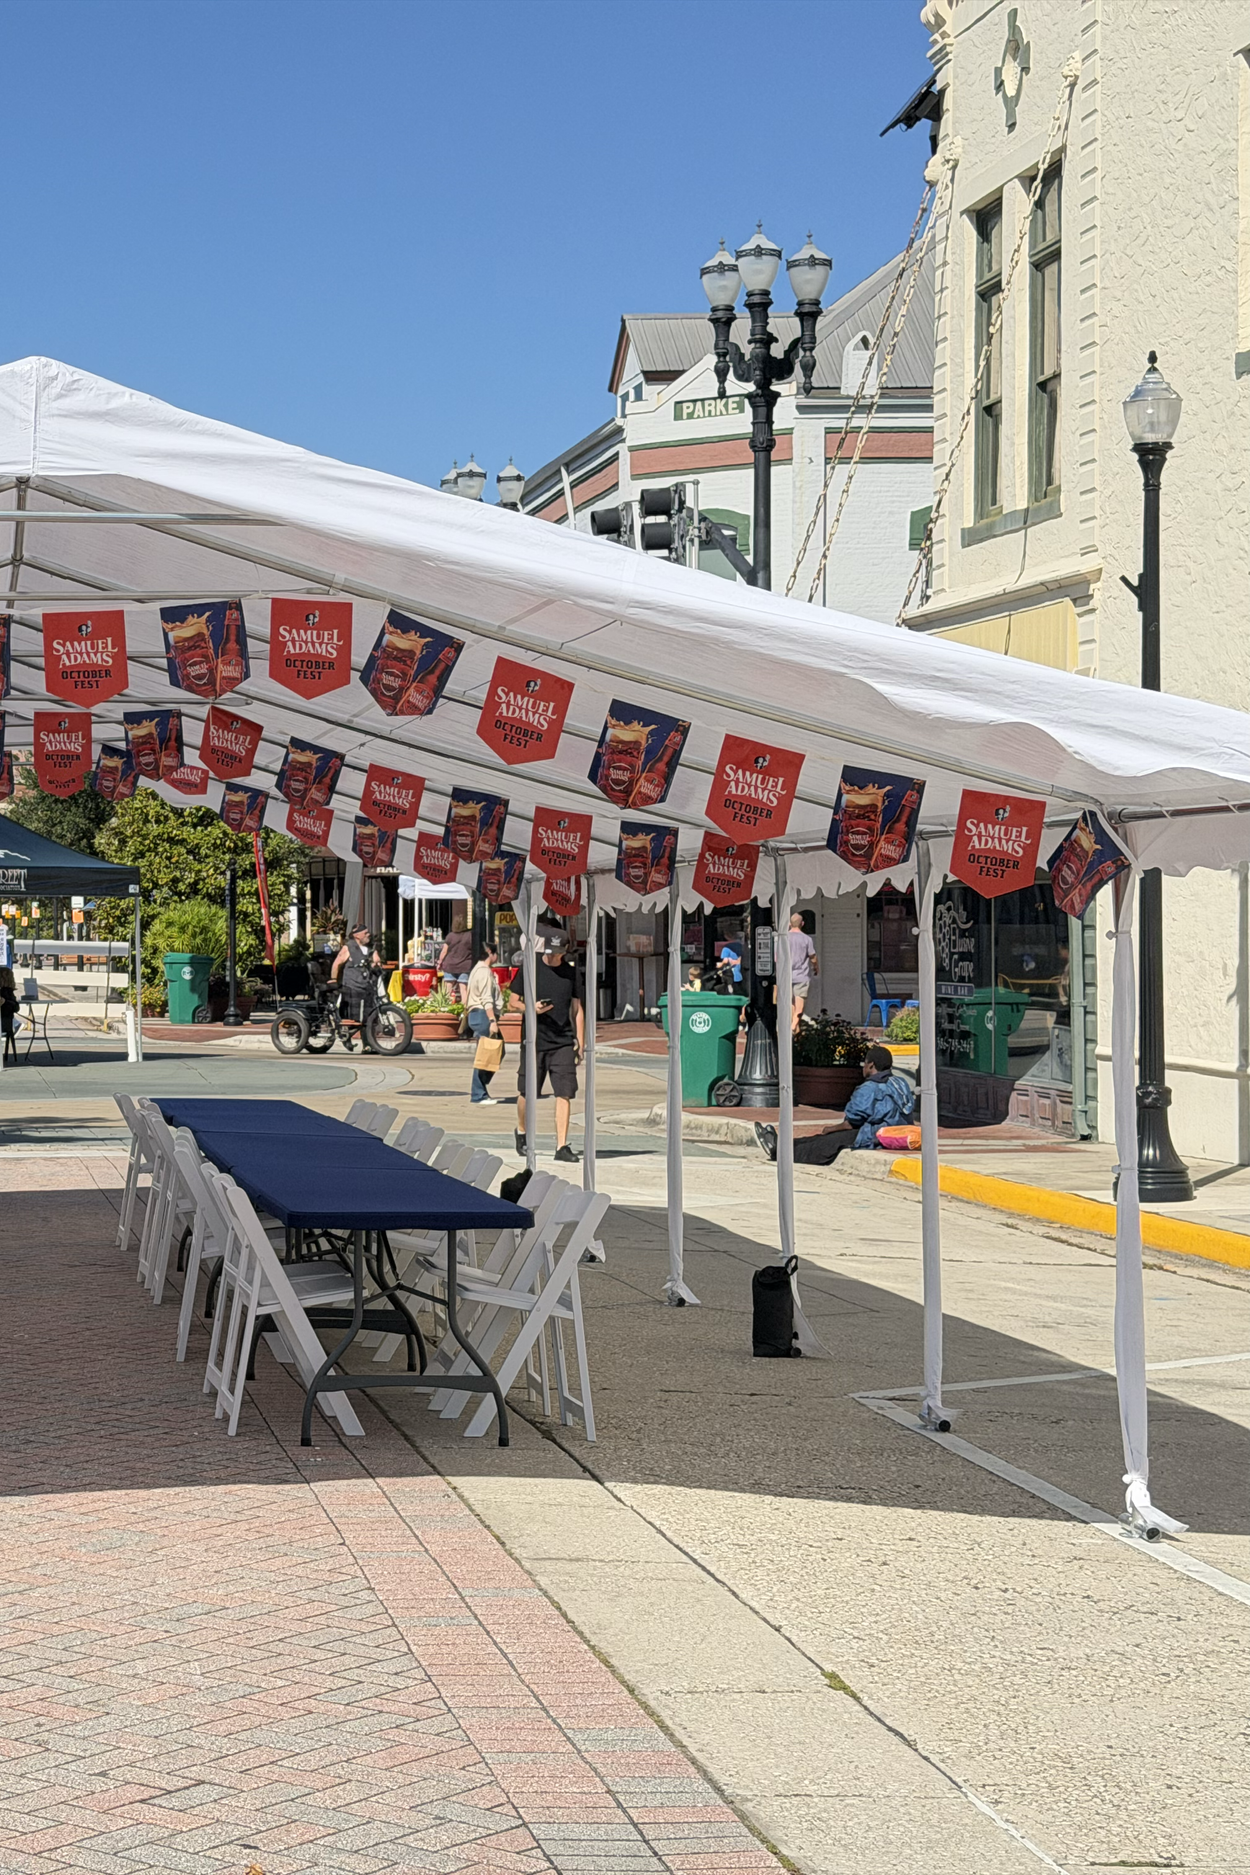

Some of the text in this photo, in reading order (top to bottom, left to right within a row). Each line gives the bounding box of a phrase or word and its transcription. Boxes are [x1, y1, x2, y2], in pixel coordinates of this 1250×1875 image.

[682, 397, 740, 420] PARKE
[279, 626, 343, 645] SAMUEL
[53, 637, 118, 655] SAMUEL
[283, 641, 338, 658] ADAMS
[59, 652, 113, 668] ADAMS
[285, 658, 336, 670] OCTOBER
[61, 669, 112, 679] OCTOBER
[297, 670, 323, 680] FEST
[74, 680, 101, 689] FEST
[495, 686, 557, 719] SAMUEL
[496, 703, 550, 730] ADAMS
[39, 731, 86, 743] SAMUEL
[210, 725, 252, 748] SAMUEL
[494, 719, 544, 743] OCTOBER
[43, 741, 82, 753] ADAMS
[211, 737, 246, 756] ADAMS
[502, 733, 529, 749] FEST
[210, 747, 242, 764] OCTOBER
[170, 770, 201, 783] ADAMS
[723, 764, 786, 795] SAMUEL
[370, 781, 415, 801] SAMUEL
[372, 791, 410, 808] ADAMS
[724, 781, 779, 807] ADAMS
[724, 798, 773, 819] OCTOBER
[292, 812, 327, 830] SAMUEL
[293, 820, 323, 835] ADAMS
[732, 812, 760, 827] FEST
[538, 826, 584, 845] SAMUEL
[965, 819, 1031, 844] SAMUEL
[419, 846, 455, 862] SAMUEL
[541, 839, 579, 854] ADAMS
[967, 836, 1024, 857] ADAMS
[421, 856, 450, 870] ADAMS
[703, 852, 750, 871] SAMUEL
[968, 853, 1020, 870] OCTOBER
[705, 864, 745, 880] ADAMS
[978, 866, 1007, 879] FEST
[705, 875, 742, 889] OCTOBER
[712, 885, 732, 894] FEST
